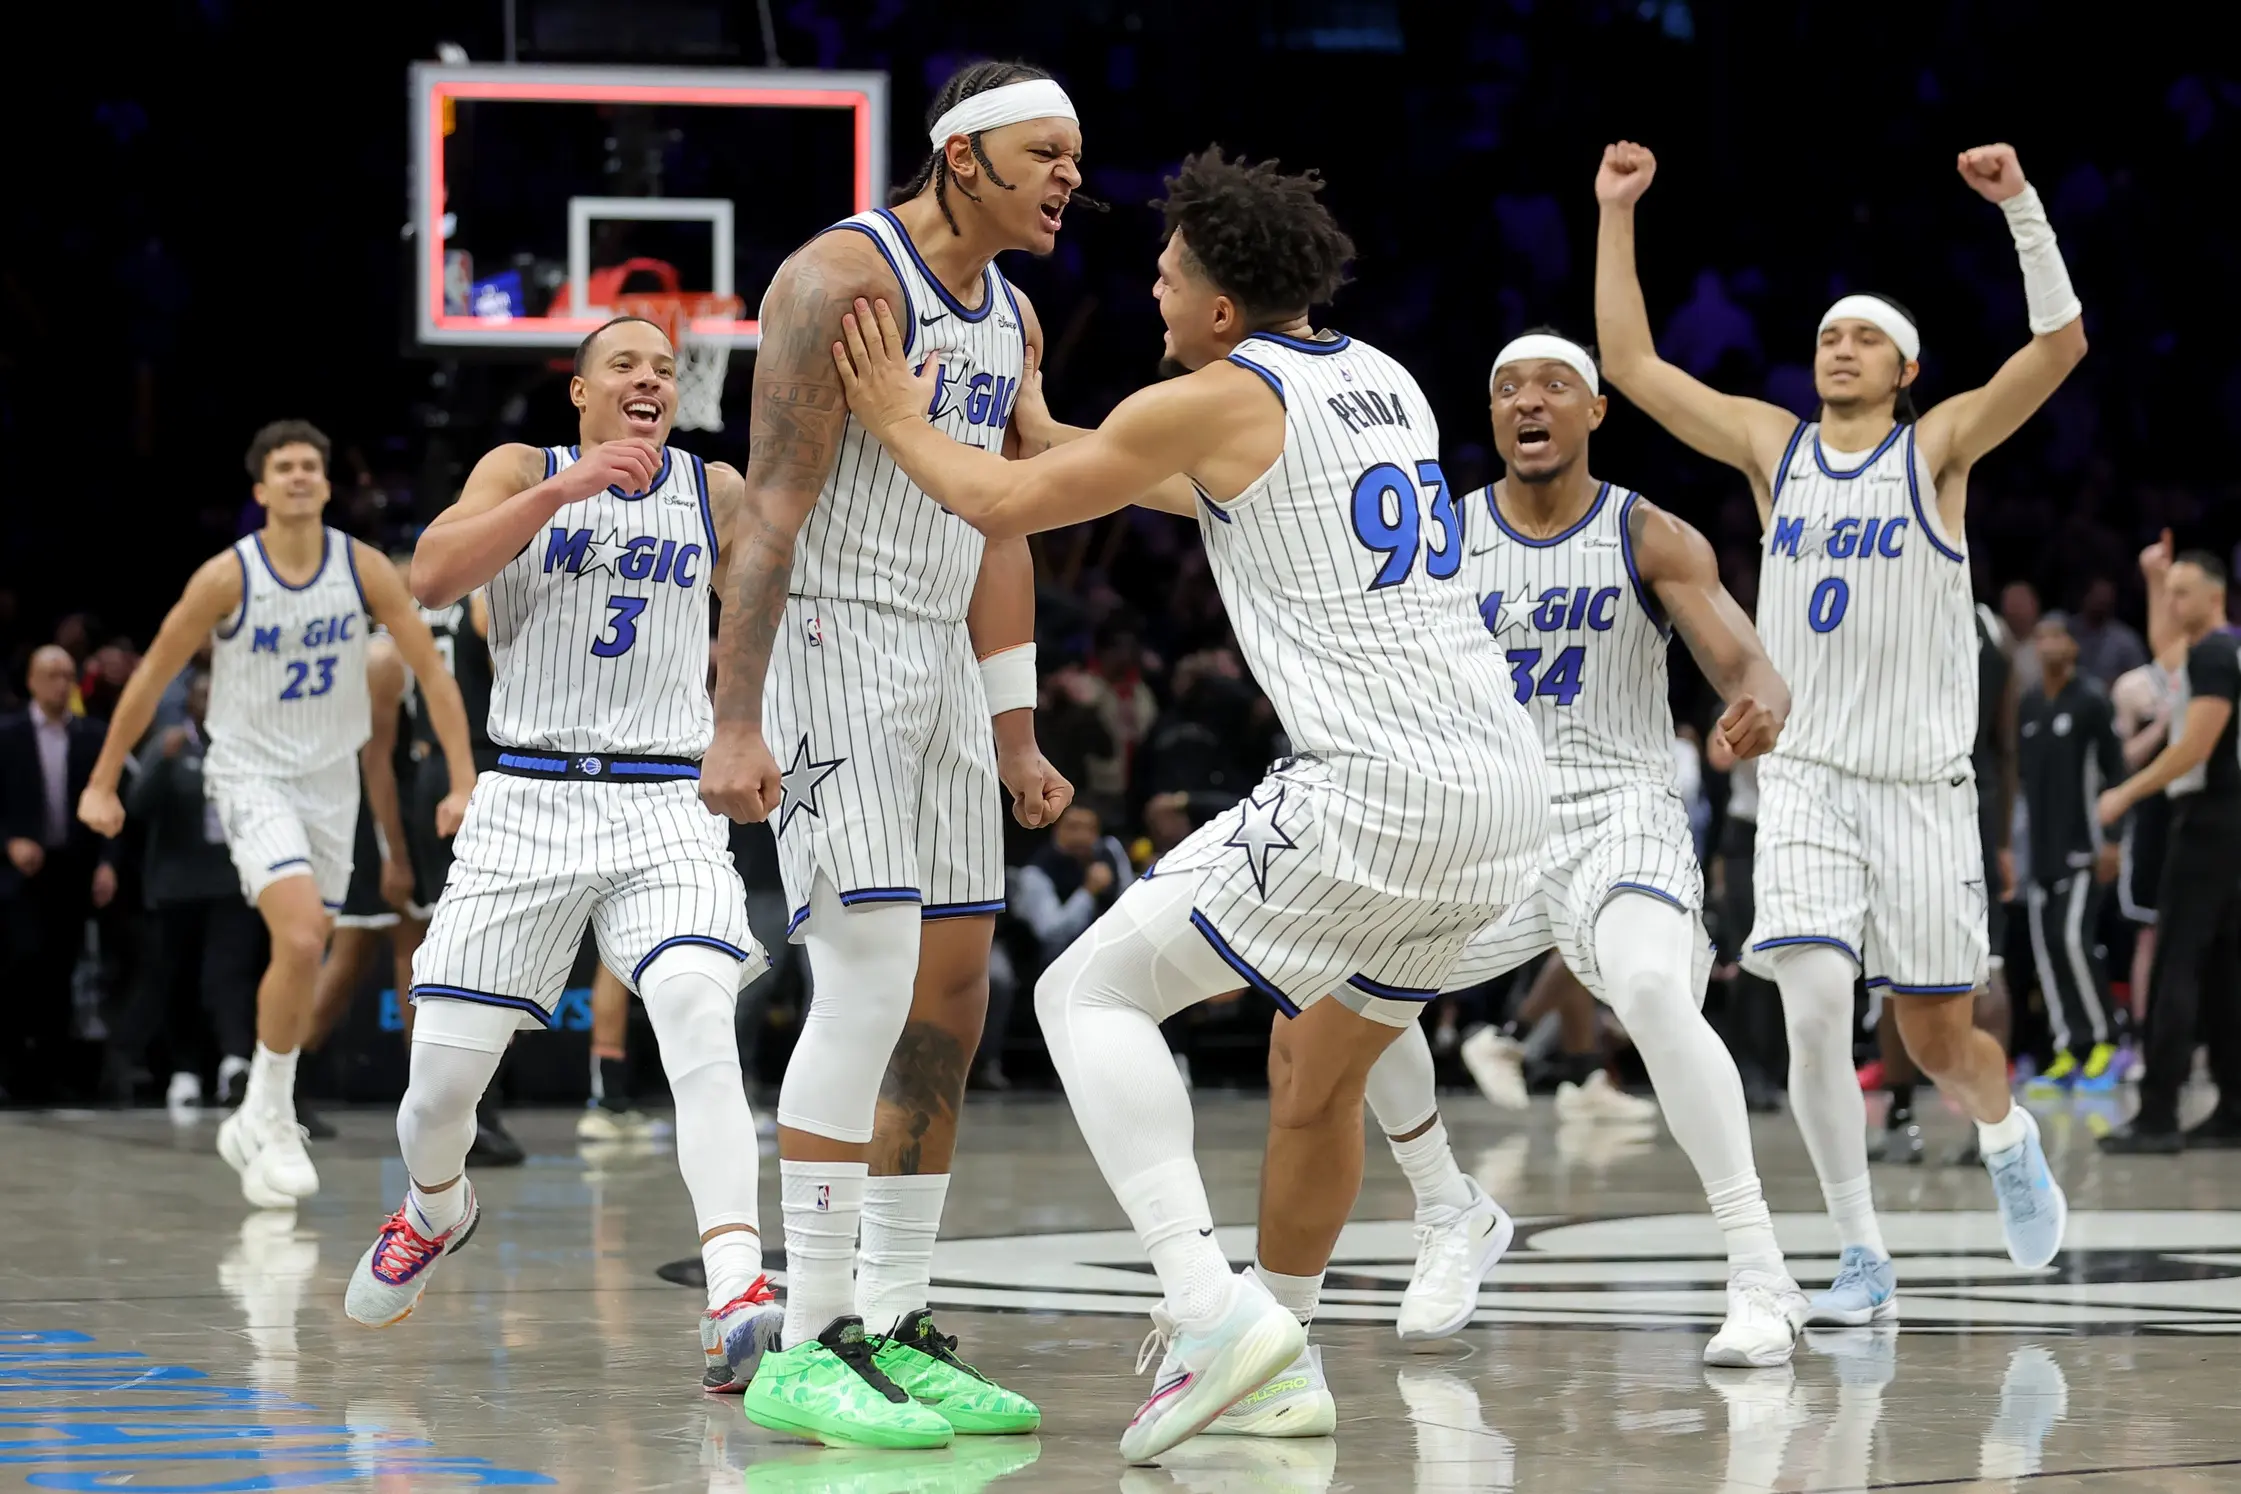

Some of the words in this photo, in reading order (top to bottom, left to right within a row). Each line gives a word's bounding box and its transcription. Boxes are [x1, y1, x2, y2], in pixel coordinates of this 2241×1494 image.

[1327, 390, 1412, 434] PENDA
[663, 490, 696, 510] Disney
[1351, 459, 1462, 591] 93
[590, 595, 649, 658] 3
[1808, 577, 1849, 633] 0
[252, 612, 357, 653] MGIC
[279, 656, 339, 700] 23
[1505, 645, 1587, 707] 34
